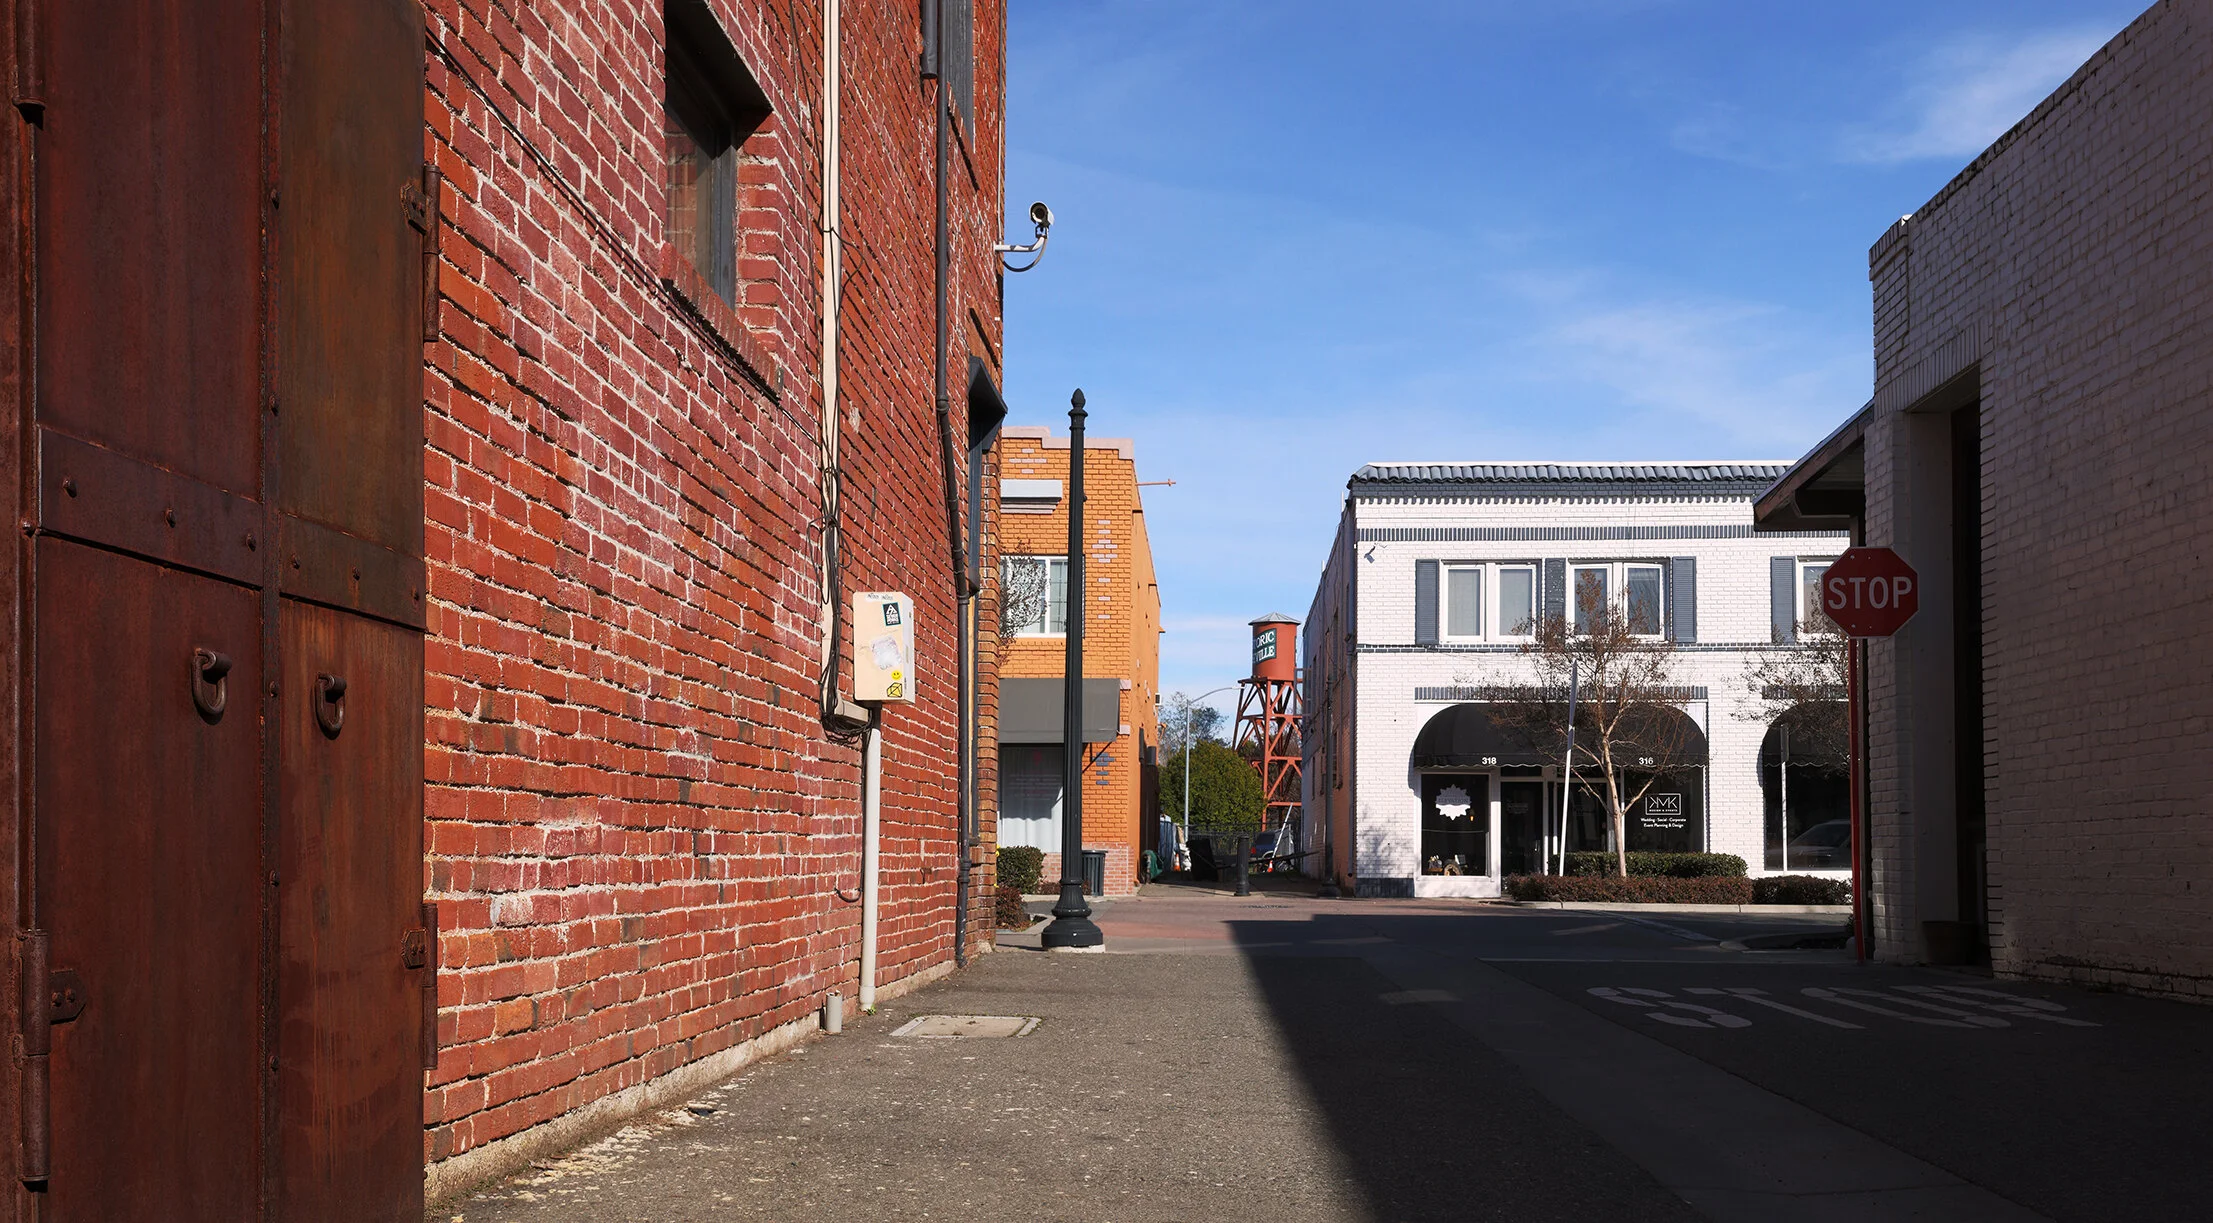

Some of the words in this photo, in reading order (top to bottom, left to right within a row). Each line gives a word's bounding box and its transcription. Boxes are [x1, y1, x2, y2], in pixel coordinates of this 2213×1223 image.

[1828, 576, 1912, 610] STOP
[1255, 631, 1275, 648] ORIC
[1481, 756, 1497, 765] 318
[1638, 757, 1654, 765] 316
[1586, 986, 2103, 1029] STOP
